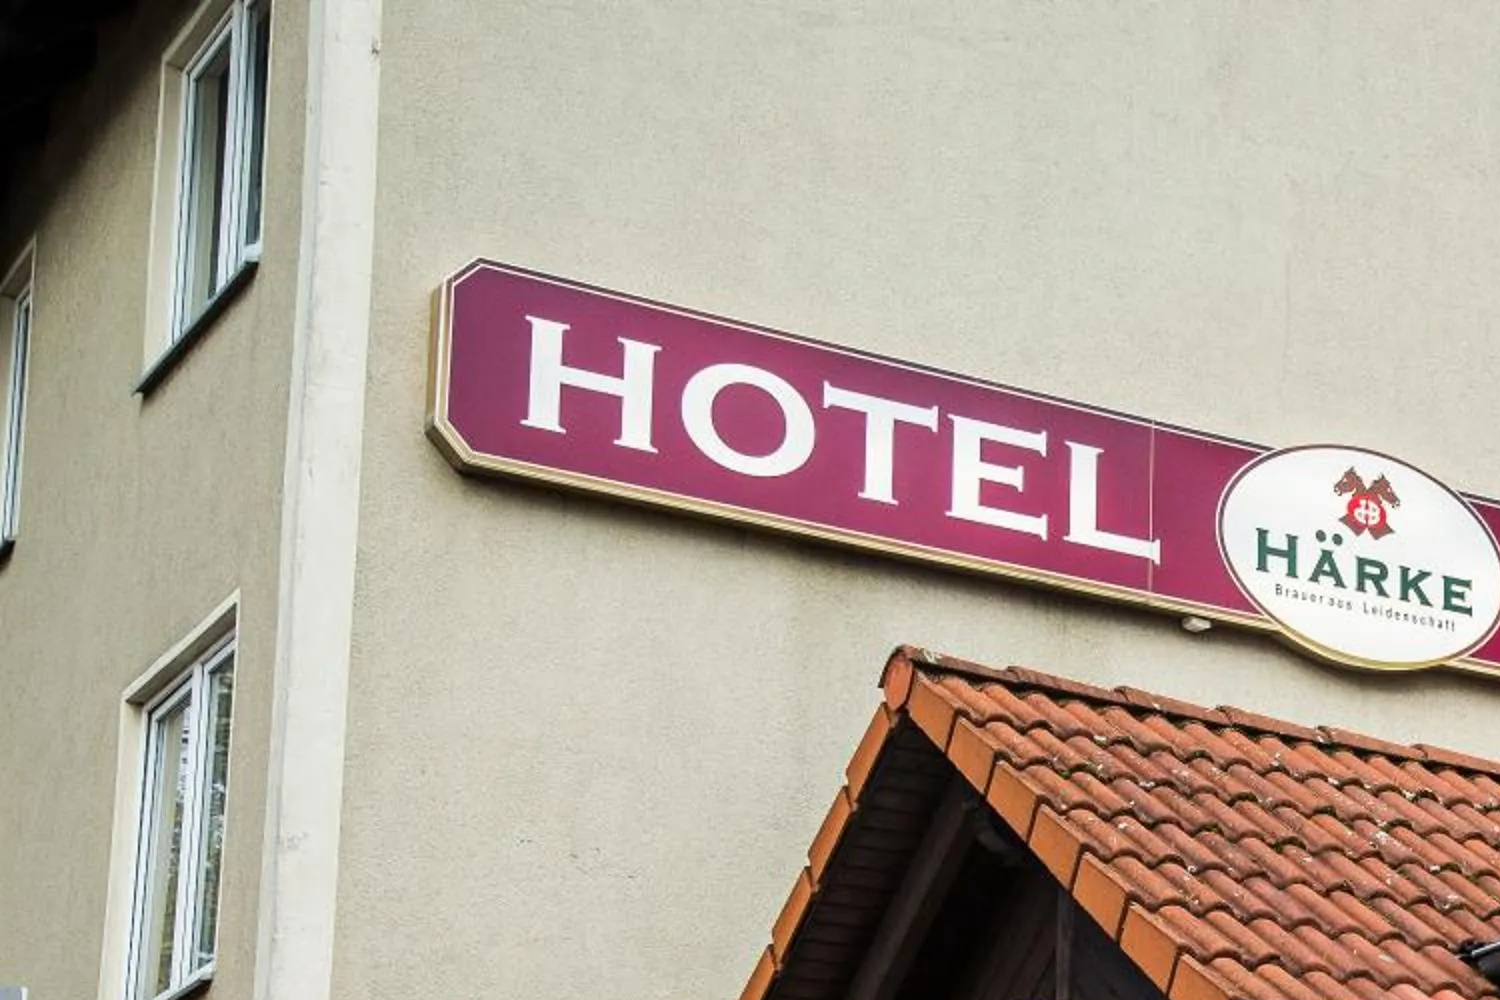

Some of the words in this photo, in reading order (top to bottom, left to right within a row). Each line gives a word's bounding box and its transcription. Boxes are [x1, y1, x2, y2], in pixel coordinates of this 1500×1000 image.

[520, 315, 1161, 565] HOTEL
[1255, 527, 1473, 618] HÄRKE
[1363, 601, 1456, 632] Leidenschaft
